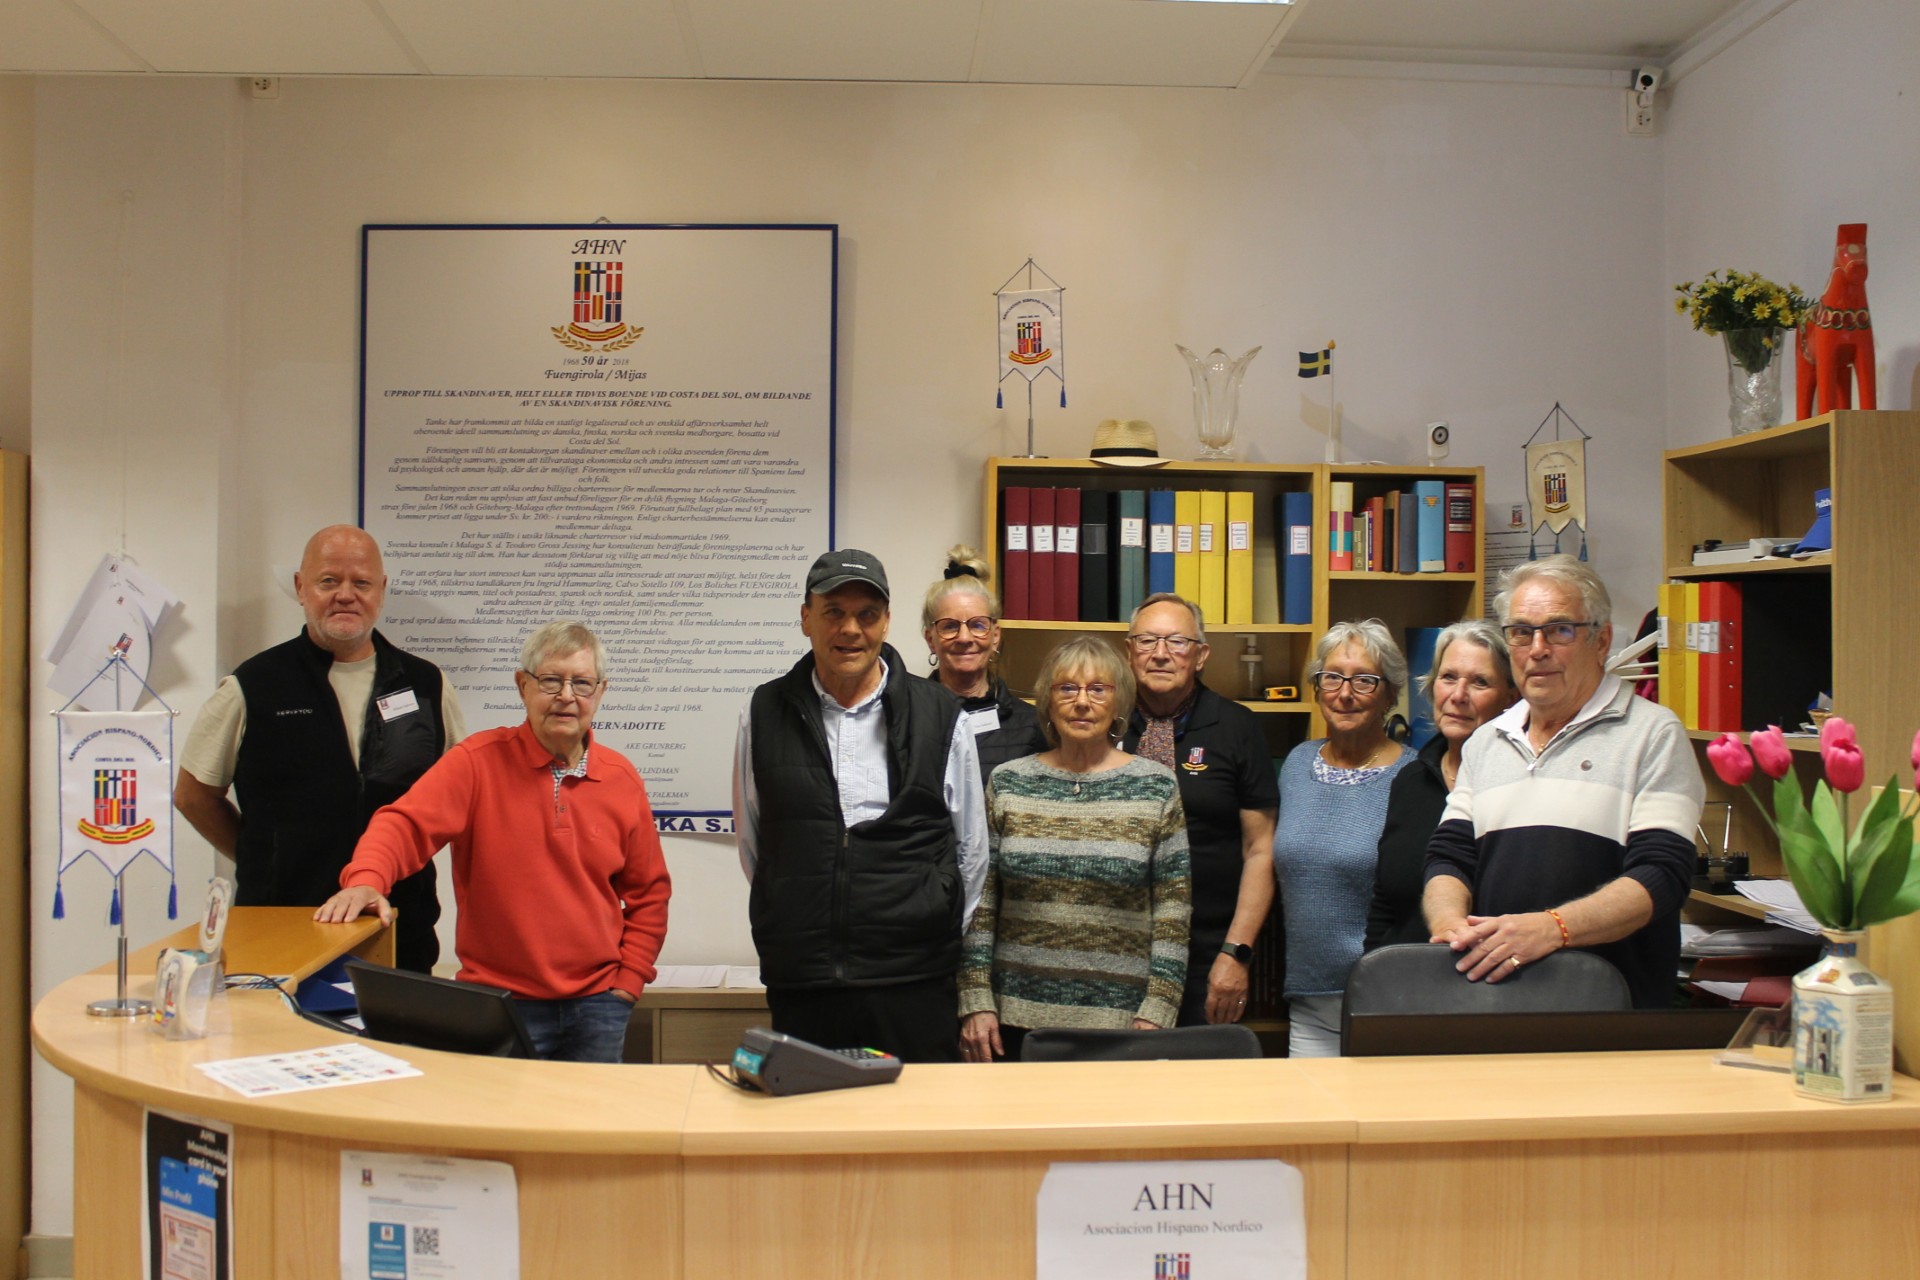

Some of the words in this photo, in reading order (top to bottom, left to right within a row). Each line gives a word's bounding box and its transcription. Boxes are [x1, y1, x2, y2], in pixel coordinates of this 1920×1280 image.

[571, 238, 627, 255] AHN
[581, 355, 595, 366] 50
[596, 355, 609, 366] år
[544, 369, 604, 382] Fuengirola
[604, 369, 614, 382] /
[614, 369, 647, 382] Mijas
[384, 390, 421, 398] UPPROP
[422, 390, 442, 398] TILL
[444, 390, 513, 398] SKANDINAVER,
[515, 390, 541, 398] HELT
[542, 390, 572, 398] ELLER
[575, 390, 607, 398] TIDVIS
[608, 390, 648, 398] BOENDE
[650, 390, 668, 399] VID
[669, 390, 700, 399] COSTA
[701, 391, 720, 399] DEL
[722, 391, 742, 400] SOL,
[744, 391, 760, 400] OM
[762, 392, 812, 400] BILDANDE
[520, 399, 532, 407] AV
[533, 399, 547, 407] EN
[548, 399, 618, 408] SKANDINAVISK
[620, 398, 673, 408] FÖRENING.
[590, 721, 666, 731] BERNADOTTE
[186, 1140, 228, 1164] Membership
[187, 1155, 206, 1169] card
[205, 1159, 212, 1171] in
[211, 1162, 228, 1178] your
[197, 1173, 219, 1190] phone
[161, 1186, 175, 1200] Min
[175, 1188, 193, 1206] Profil
[1133, 1182, 1215, 1212] AHN
[1083, 1222, 1153, 1236] Asociacion
[1157, 1221, 1209, 1237] Hispano
[1212, 1219, 1263, 1234] Nordico
